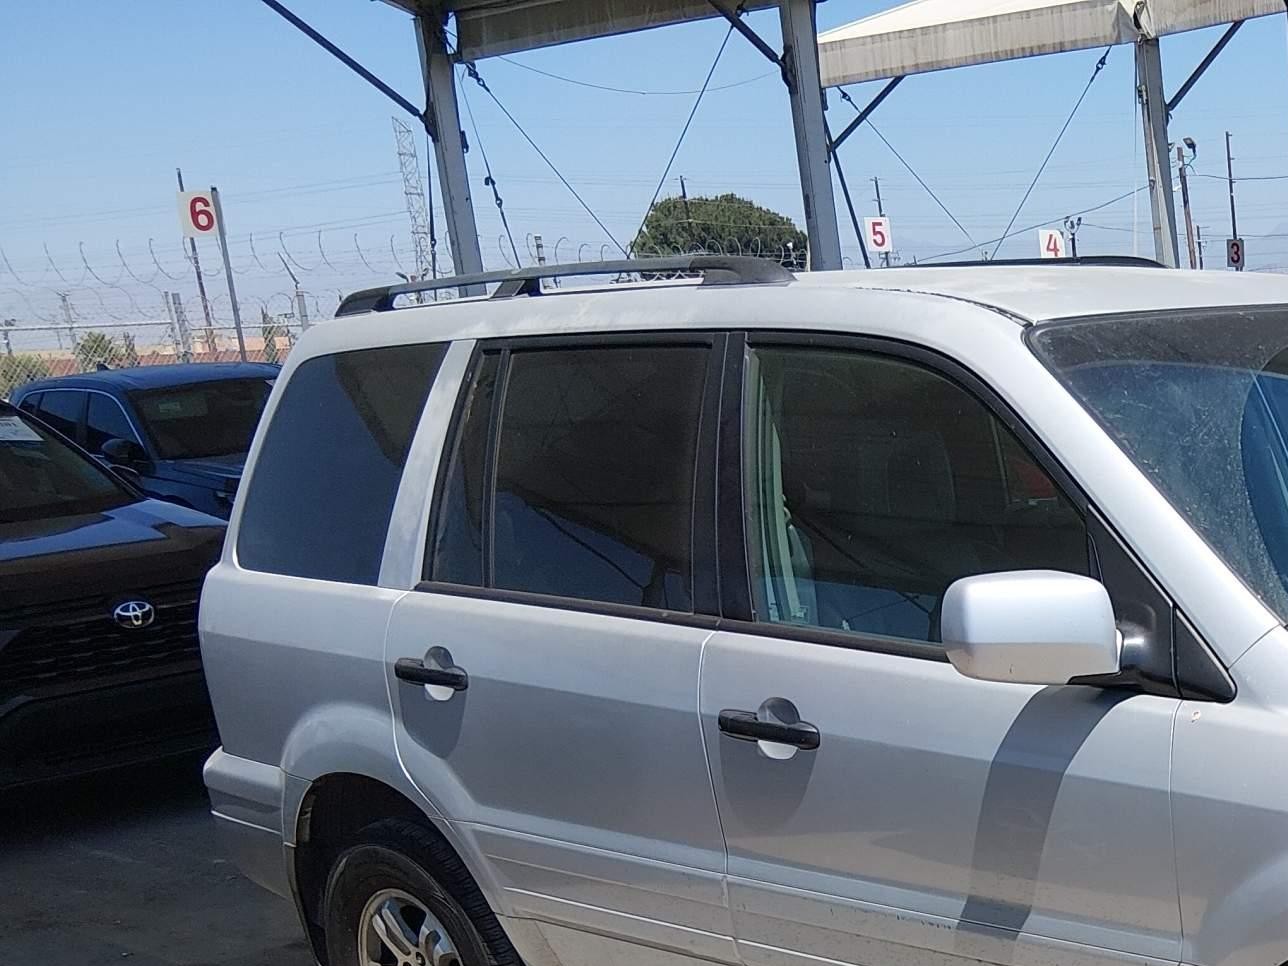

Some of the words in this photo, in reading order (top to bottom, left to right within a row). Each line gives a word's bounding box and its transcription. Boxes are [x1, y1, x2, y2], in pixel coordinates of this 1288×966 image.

[190, 196, 214, 232] 6
[871, 221, 886, 248] 5
[1046, 233, 1060, 257] 4
[1230, 242, 1241, 264] 3
